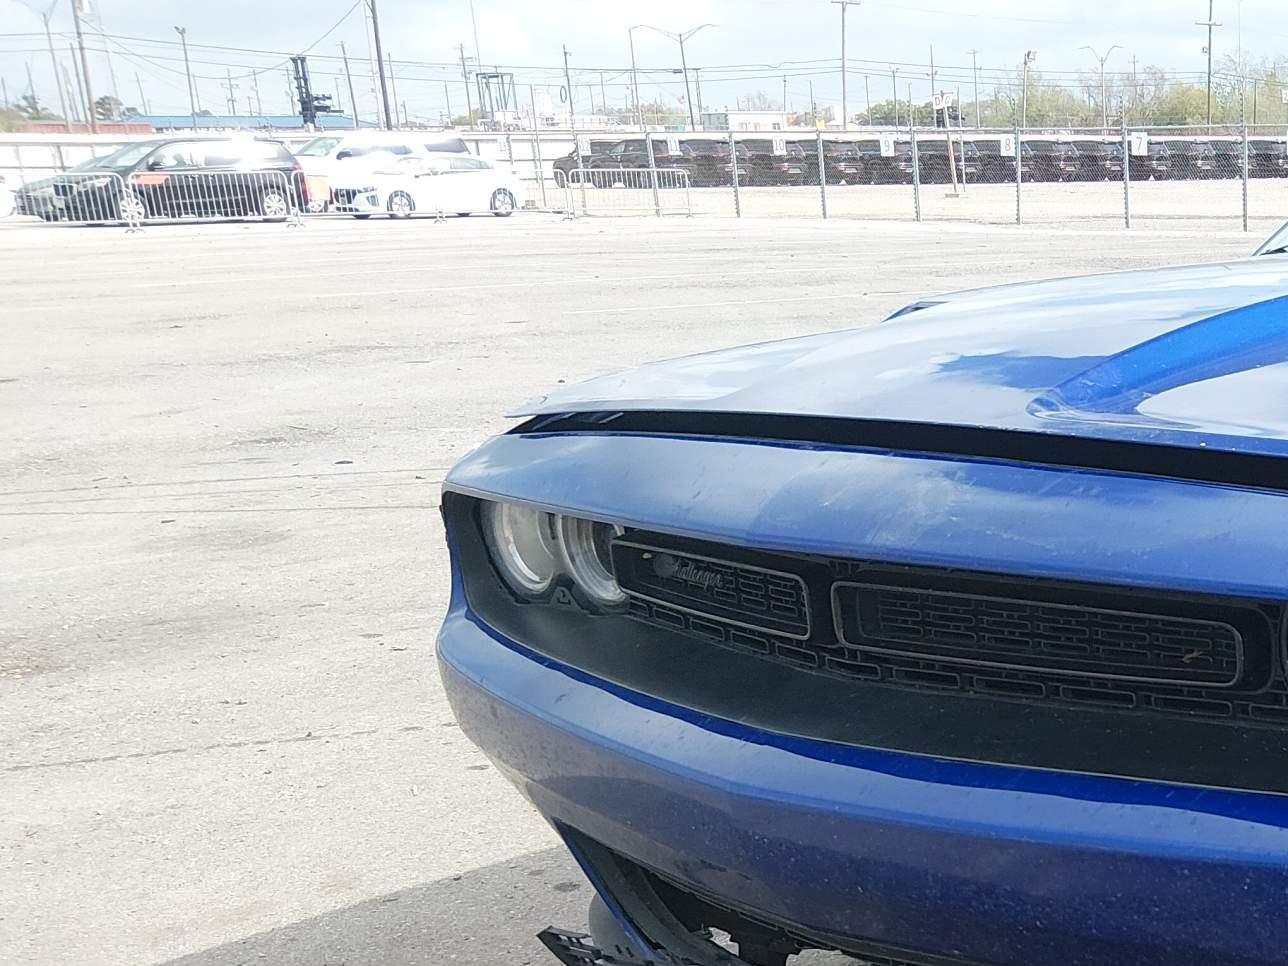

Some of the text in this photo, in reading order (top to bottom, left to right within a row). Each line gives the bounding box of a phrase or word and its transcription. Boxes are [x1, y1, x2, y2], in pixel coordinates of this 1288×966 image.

[773, 138, 785, 151] 10
[884, 138, 891, 151] 9
[1004, 137, 1012, 151] 8
[1136, 136, 1144, 151] 7
